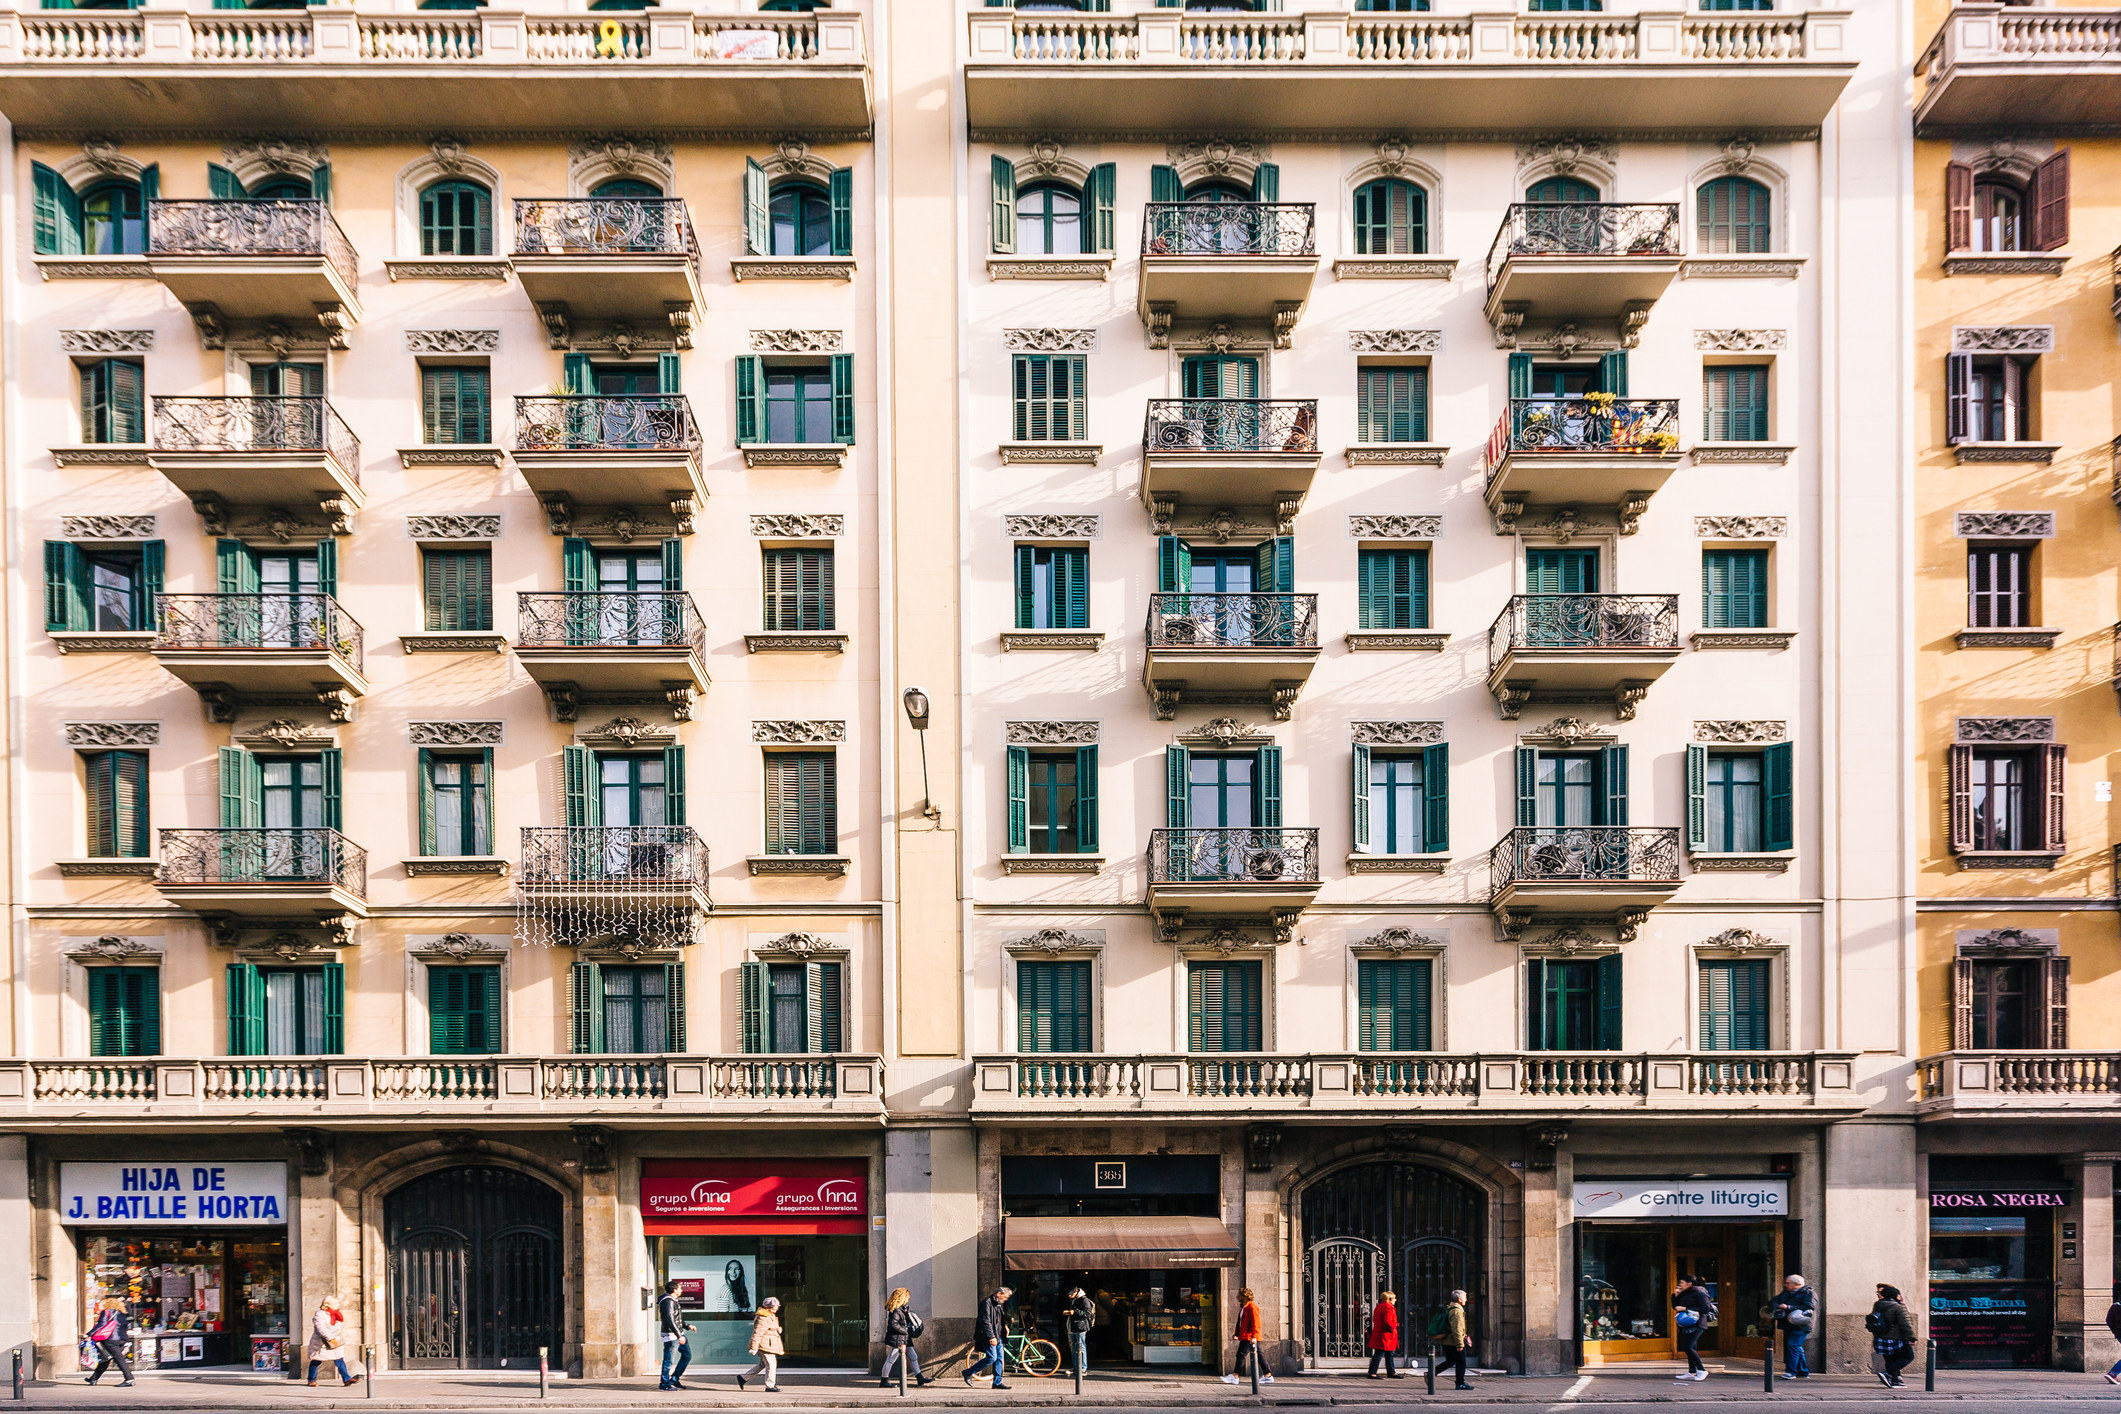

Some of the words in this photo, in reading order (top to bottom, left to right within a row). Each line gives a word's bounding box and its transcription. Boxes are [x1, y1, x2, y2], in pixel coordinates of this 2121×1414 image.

[122, 1167, 181, 1191] HIJA
[193, 1167, 225, 1191] DE
[1099, 1170, 1122, 1181] 365
[649, 1195, 688, 1206] grupo
[699, 1188, 731, 1203] hna
[776, 1194, 815, 1205] grupo
[826, 1187, 857, 1203] hna
[1639, 1190, 1705, 1205] centre
[1711, 1188, 1779, 1208] litúrgic
[1931, 1193, 1988, 1207] ROSA
[1992, 1193, 2065, 1206] NEGRA
[68, 1195, 90, 1219] J.
[97, 1195, 187, 1219] BATLLE
[198, 1195, 280, 1219] HORTA
[655, 1205, 682, 1213] Seguros
[1969, 1297, 2027, 1309] MEXICANA
